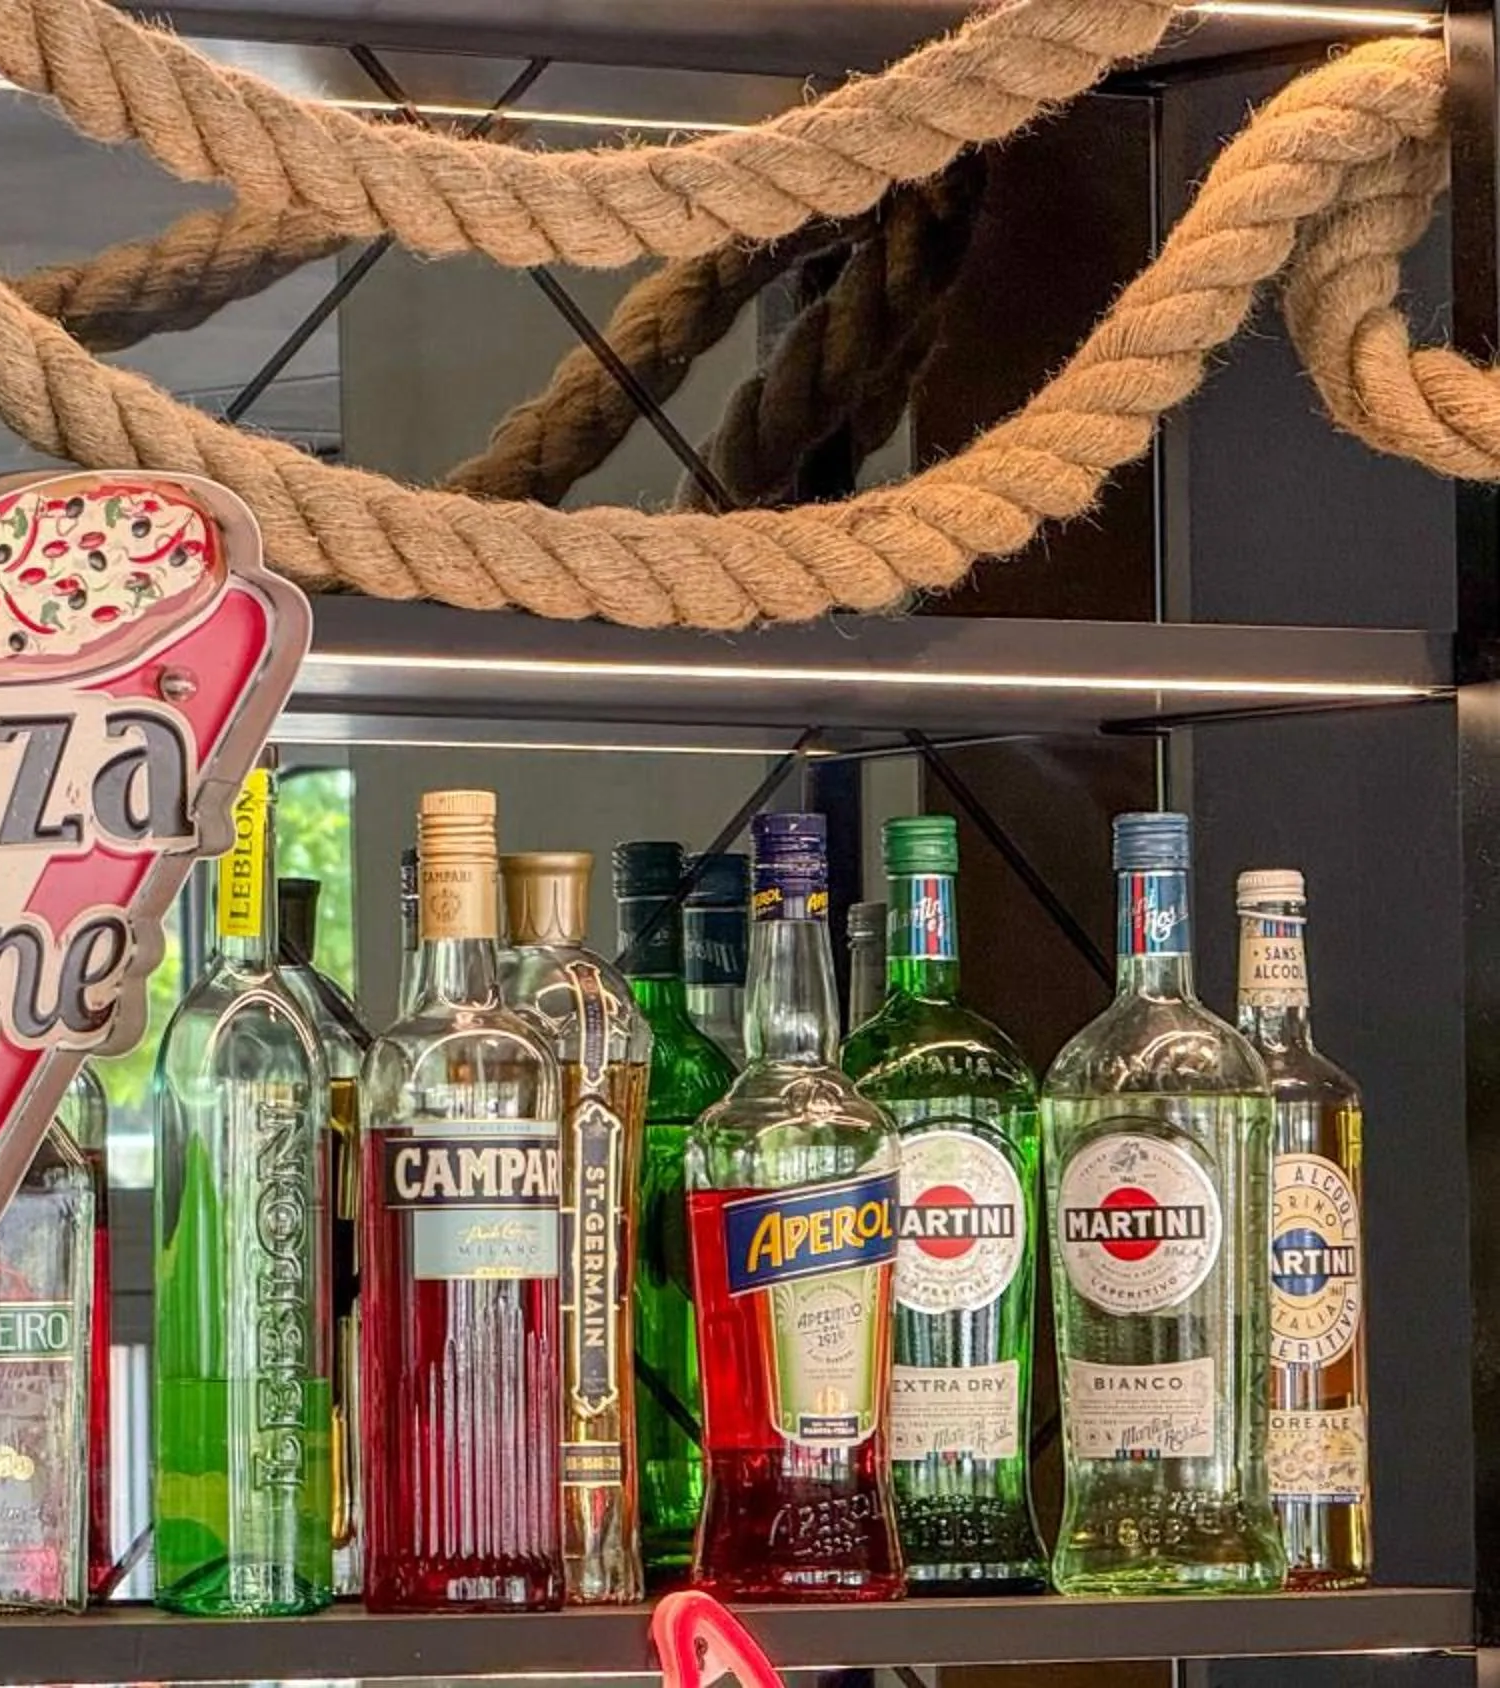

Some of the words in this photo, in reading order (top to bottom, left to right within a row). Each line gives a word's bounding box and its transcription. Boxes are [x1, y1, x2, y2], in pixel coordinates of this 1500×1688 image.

[229, 790, 254, 918] LEBLON
[1265, 946, 1297, 961] SANS
[1254, 964, 1304, 979] ALCOOL
[395, 1147, 559, 1200] CAMPAR
[1274, 1195, 1337, 1228] ORINO
[1294, 1165, 1354, 1230] ALCOOL
[747, 1198, 893, 1273] APEROL
[901, 1207, 1011, 1236] ARTINI
[1068, 1208, 1200, 1239] MARTINI
[583, 1166, 606, 1348] ST-GERMAIN
[1273, 1250, 1354, 1277] ARTINI
[254, 1098, 306, 1490] LEBLON
[1271, 1298, 1356, 1361] ERITIVO
[1273, 1303, 1338, 1331] TALIA
[967, 1378, 1005, 1393] DRY
[1094, 1377, 1184, 1391] BIANCO
[1272, 1417, 1349, 1430] OREALE
